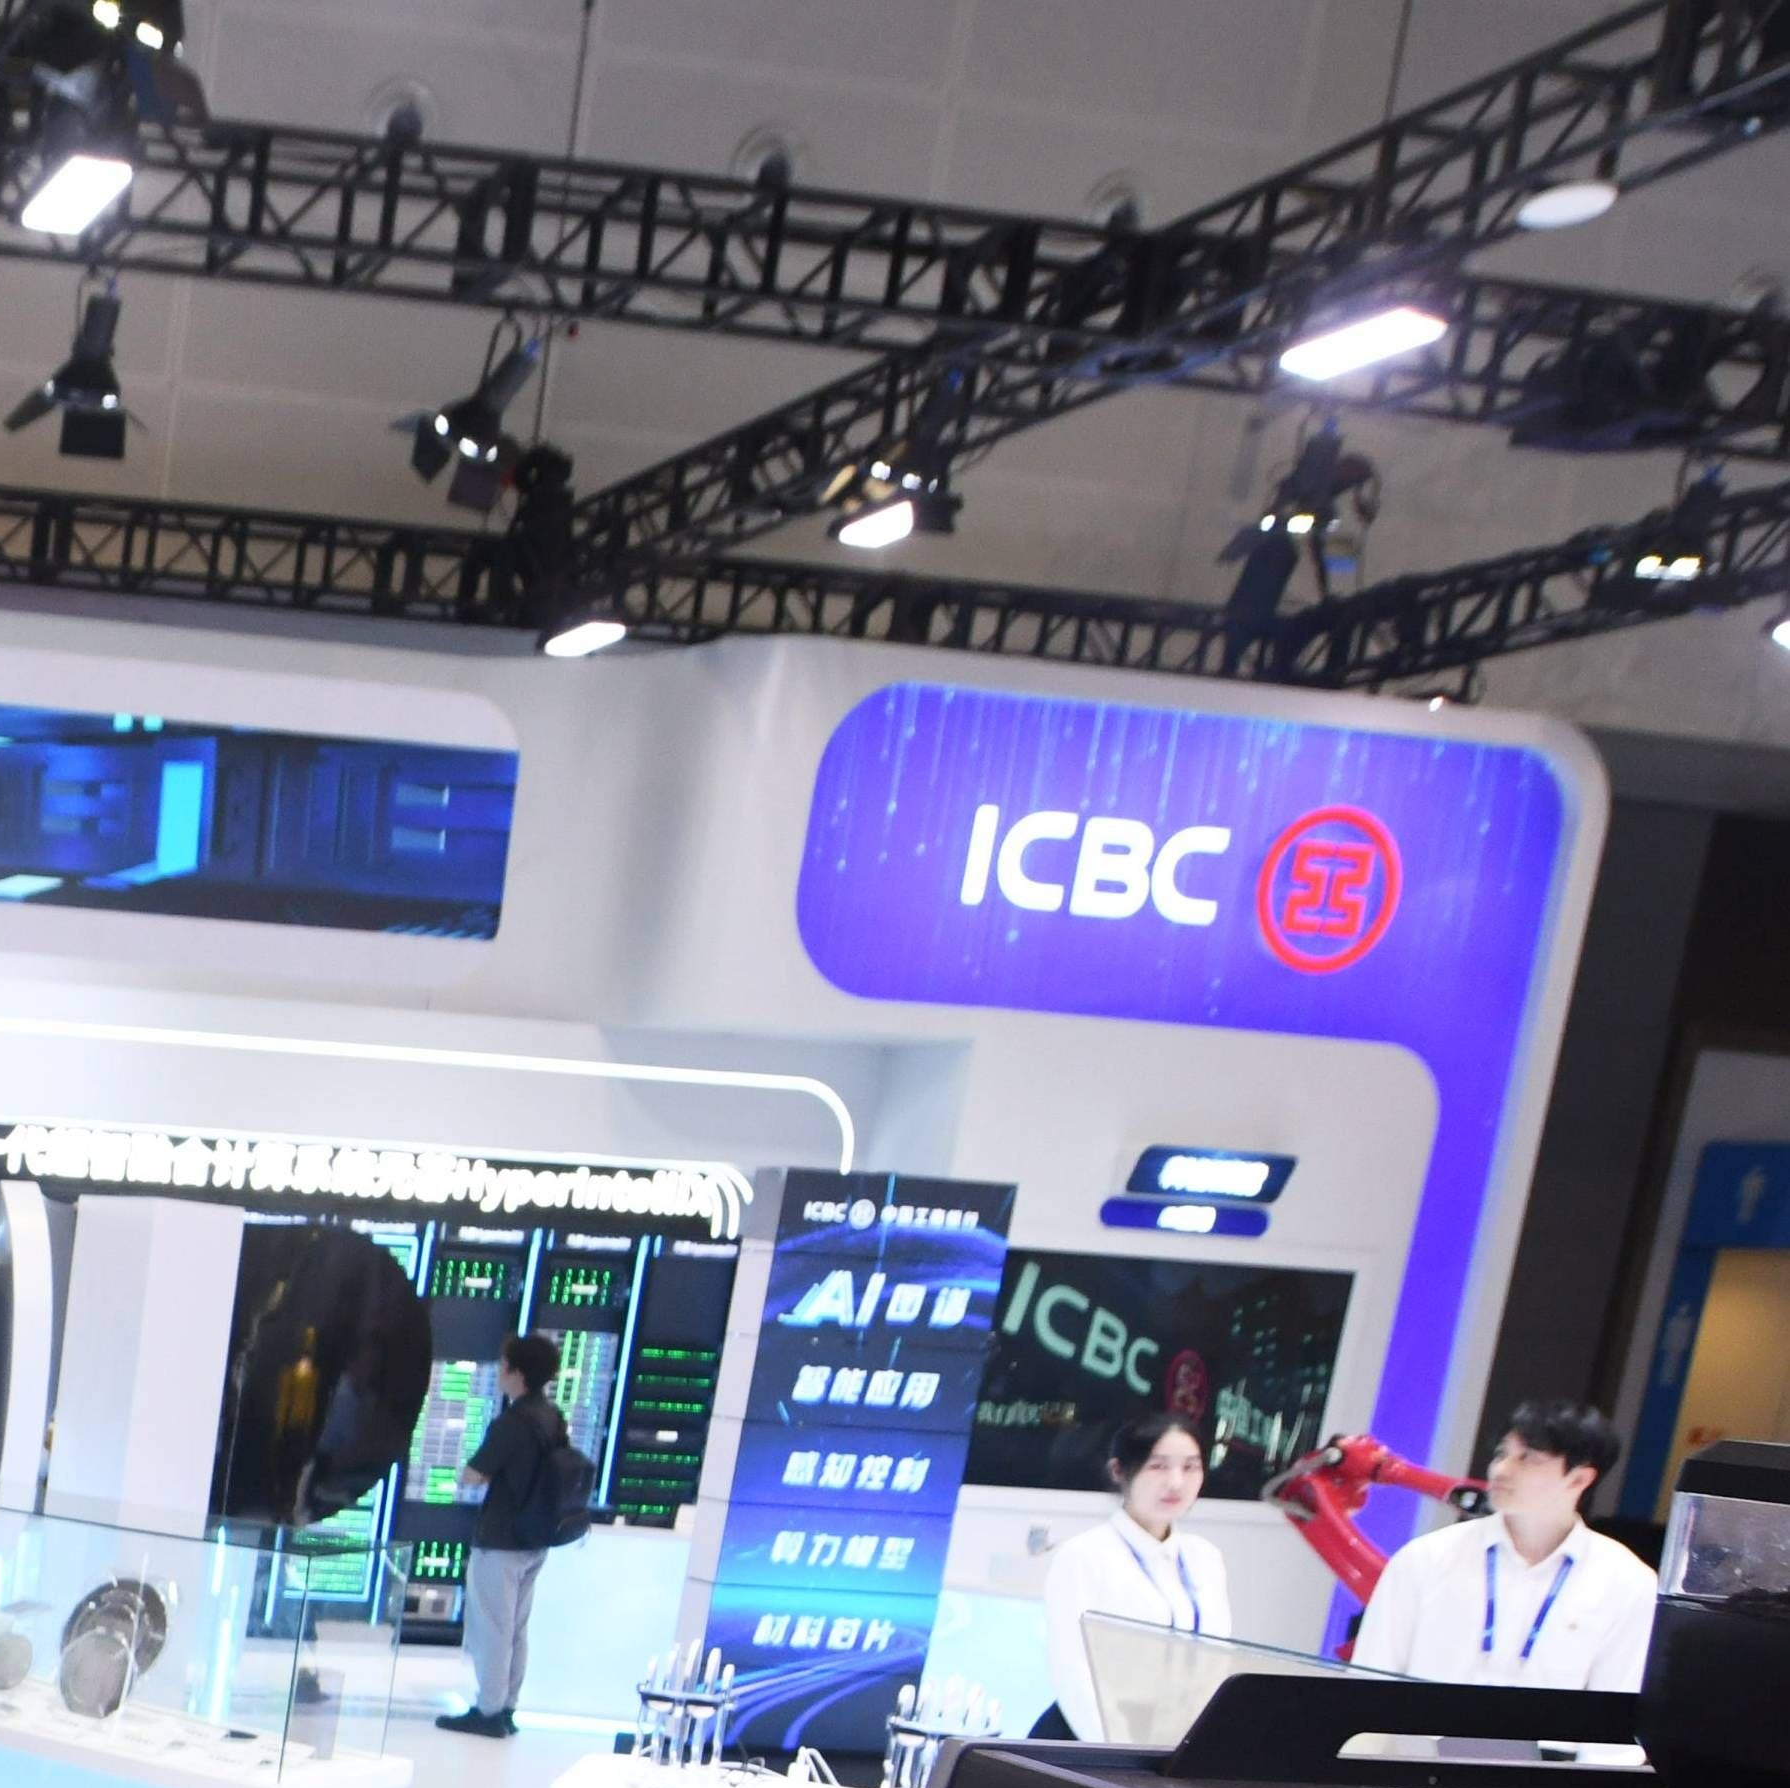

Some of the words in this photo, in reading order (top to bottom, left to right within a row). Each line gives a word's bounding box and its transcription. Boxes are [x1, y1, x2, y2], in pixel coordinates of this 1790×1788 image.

[960, 804, 1231, 926] ICBC
[803, 1200, 849, 1223] ICBC
[1002, 1261, 1160, 1395] ICBC
[791, 1364, 941, 1410] 智能应用
[781, 1451, 931, 1494] 感知控制
